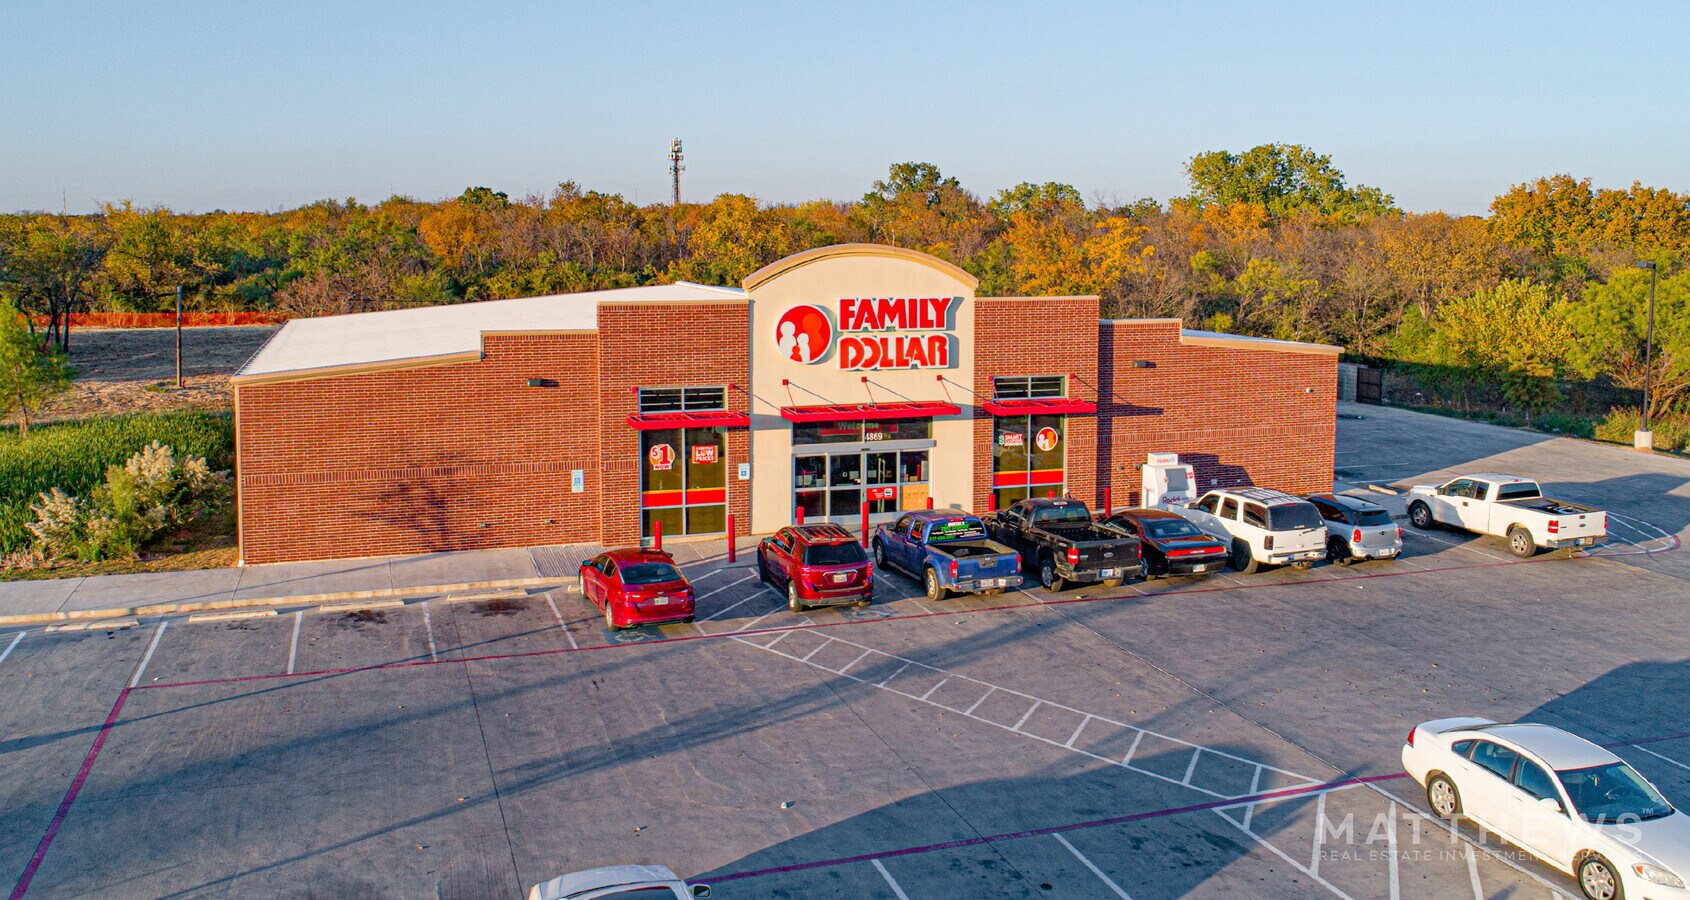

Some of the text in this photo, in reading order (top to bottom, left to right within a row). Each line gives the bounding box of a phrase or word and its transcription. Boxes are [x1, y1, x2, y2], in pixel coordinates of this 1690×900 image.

[838, 297, 953, 331] FAMILY
[838, 334, 949, 370] DOLLAR
[865, 432, 883, 441] 4869
